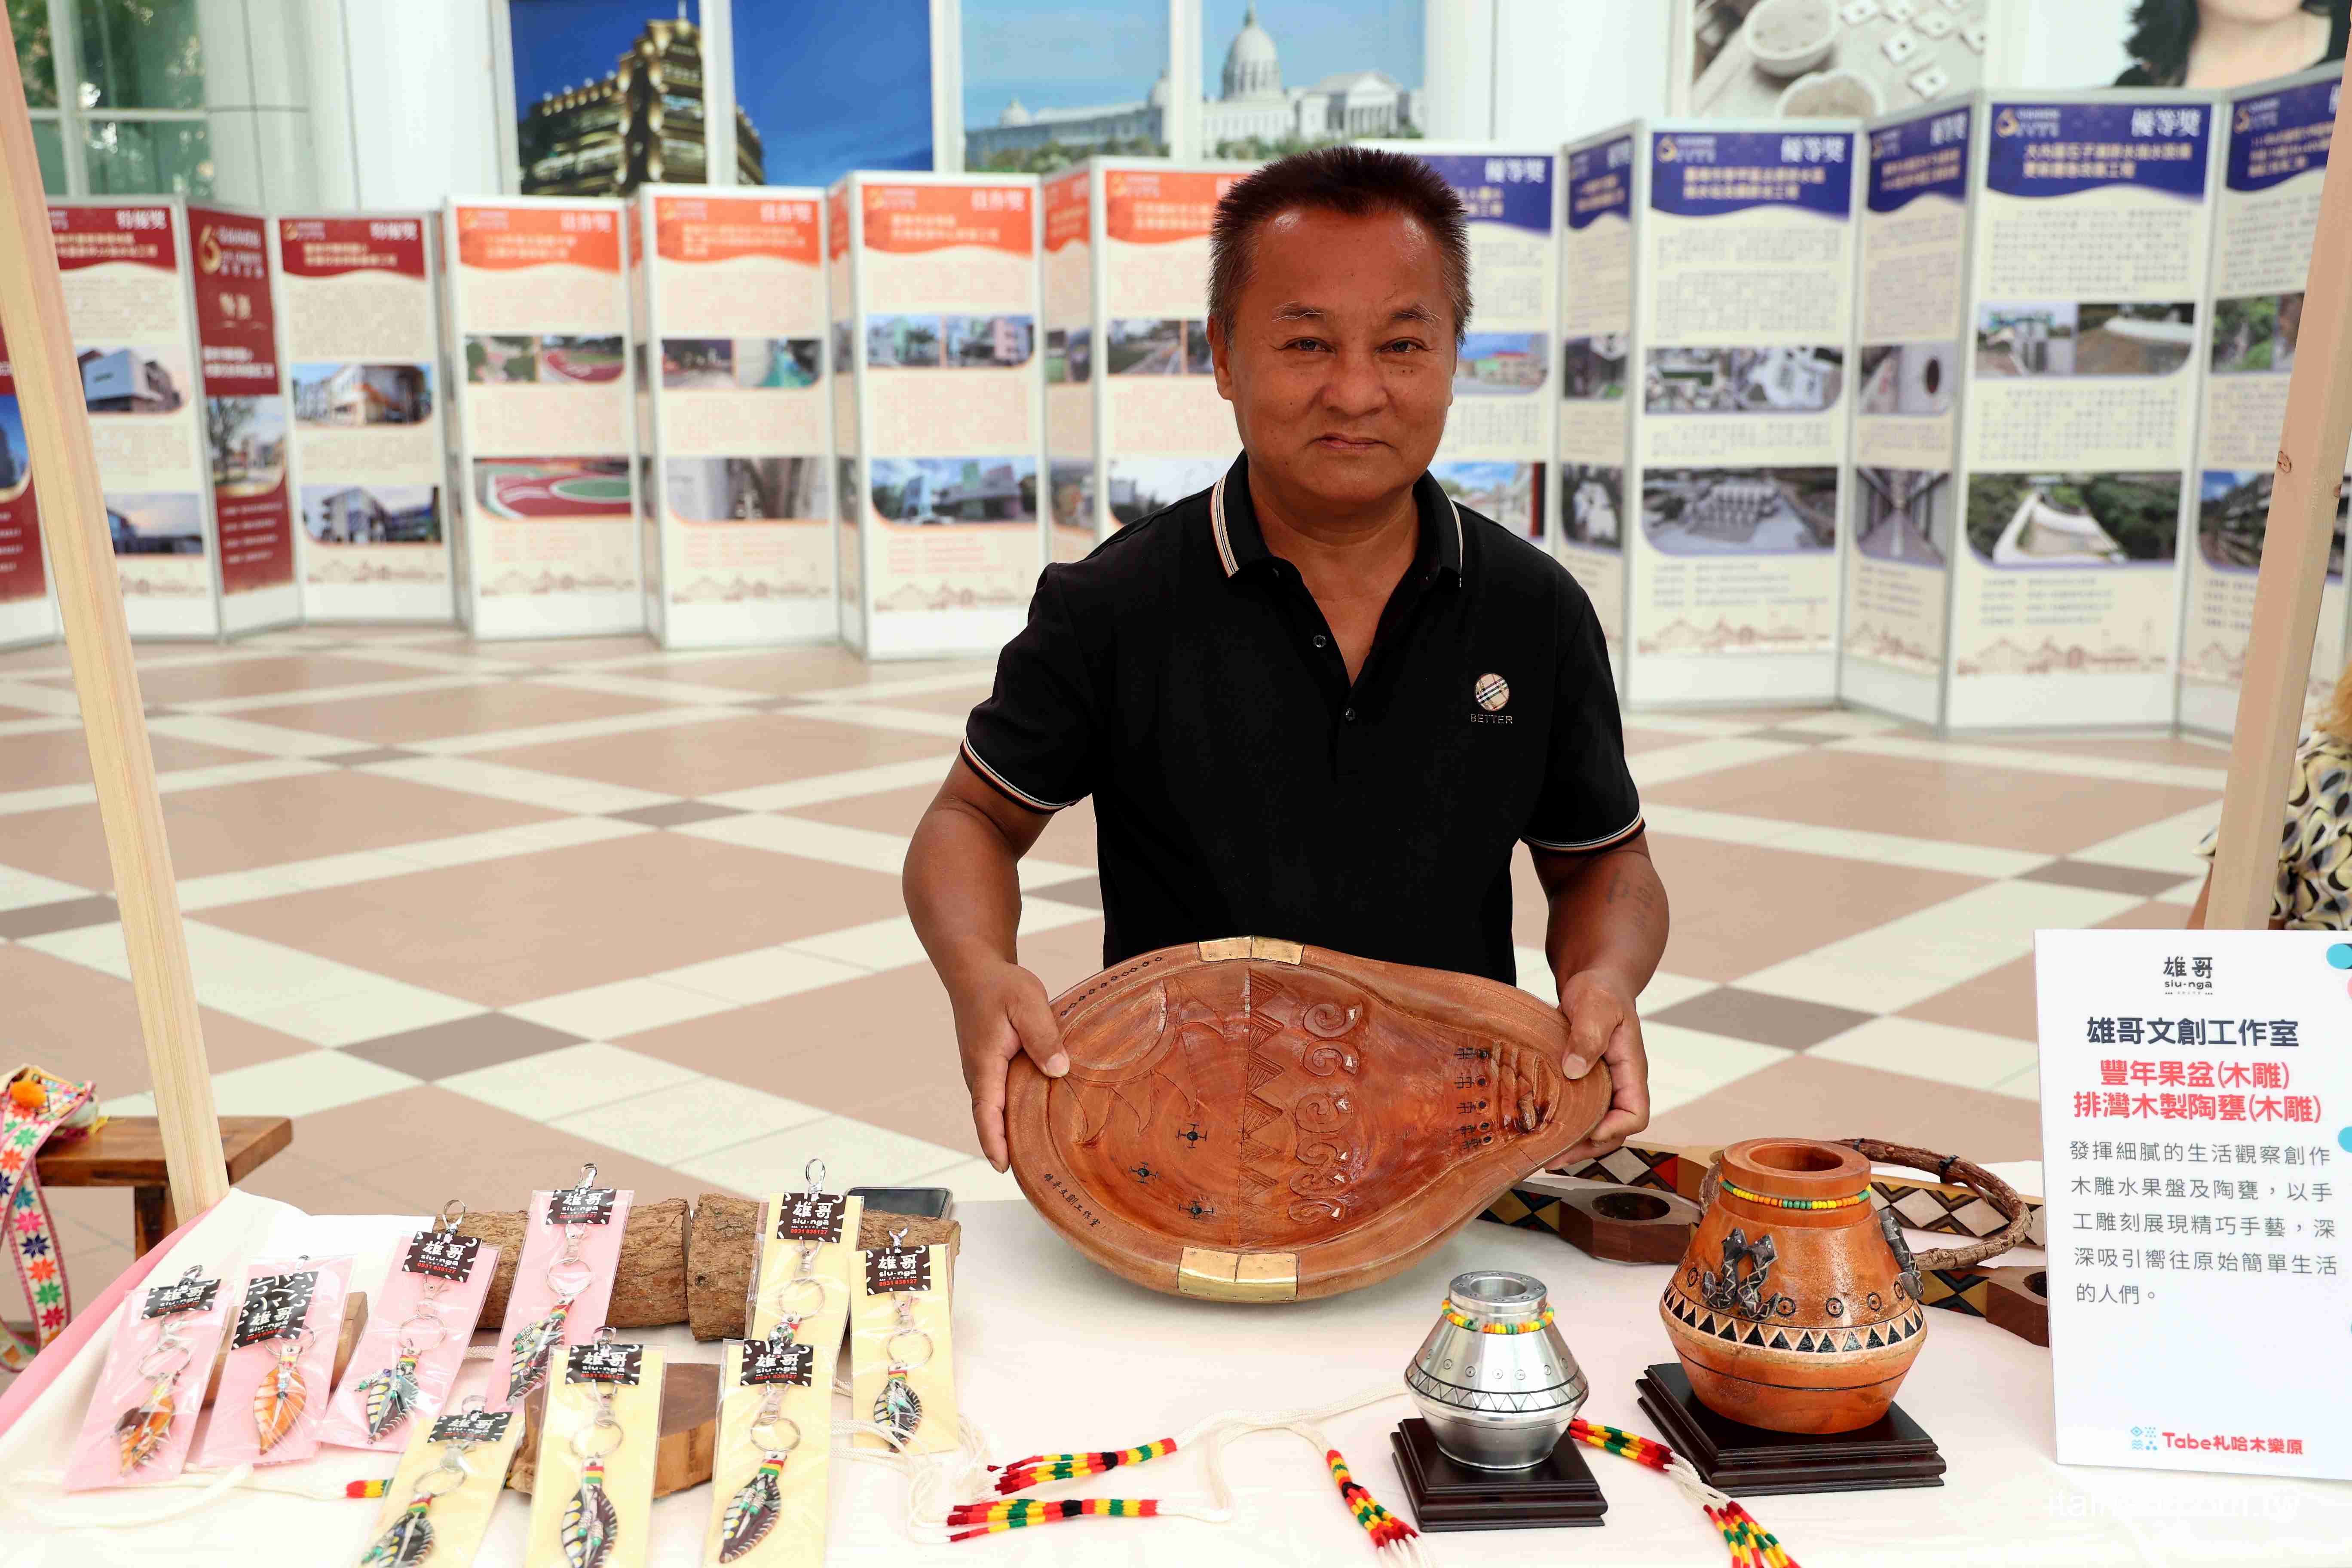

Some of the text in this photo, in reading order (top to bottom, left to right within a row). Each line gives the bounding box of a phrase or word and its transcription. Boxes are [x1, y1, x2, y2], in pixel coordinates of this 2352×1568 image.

[1470, 714, 1513, 724] BETTER
[2163, 956, 2213, 979] 雄哥
[2087, 1016, 2300, 1047] 雄哥文創工作室
[2101, 1059, 2289, 1090] 豐年果盆(木雕)
[2073, 1091, 2321, 1123] 排灣木製陶甕(木雕)
[2069, 1140, 2331, 1166] 發揮細膩的生活觀察創作
[562, 1193, 604, 1206] 雄哥
[2070, 1175, 2333, 1203] 木雕水果盤及陶甕，以手
[792, 1200, 833, 1219] 雄哥
[792, 1218, 829, 1226] siu-nga
[2073, 1212, 2336, 1239] 工雕刻展現精巧手藝，深
[422, 1240, 466, 1261] 雄哥
[2074, 1246, 2337, 1276] 深吸引嚮往原始簡單生活
[877, 1253, 917, 1270] 雄哥
[879, 1269, 917, 1277] siu-nga
[2076, 1283, 2155, 1305] 的人們。
[249, 1306, 295, 1326] 雄哥
[582, 1351, 628, 1367] 雄哥
[755, 1353, 800, 1367] 雄哥
